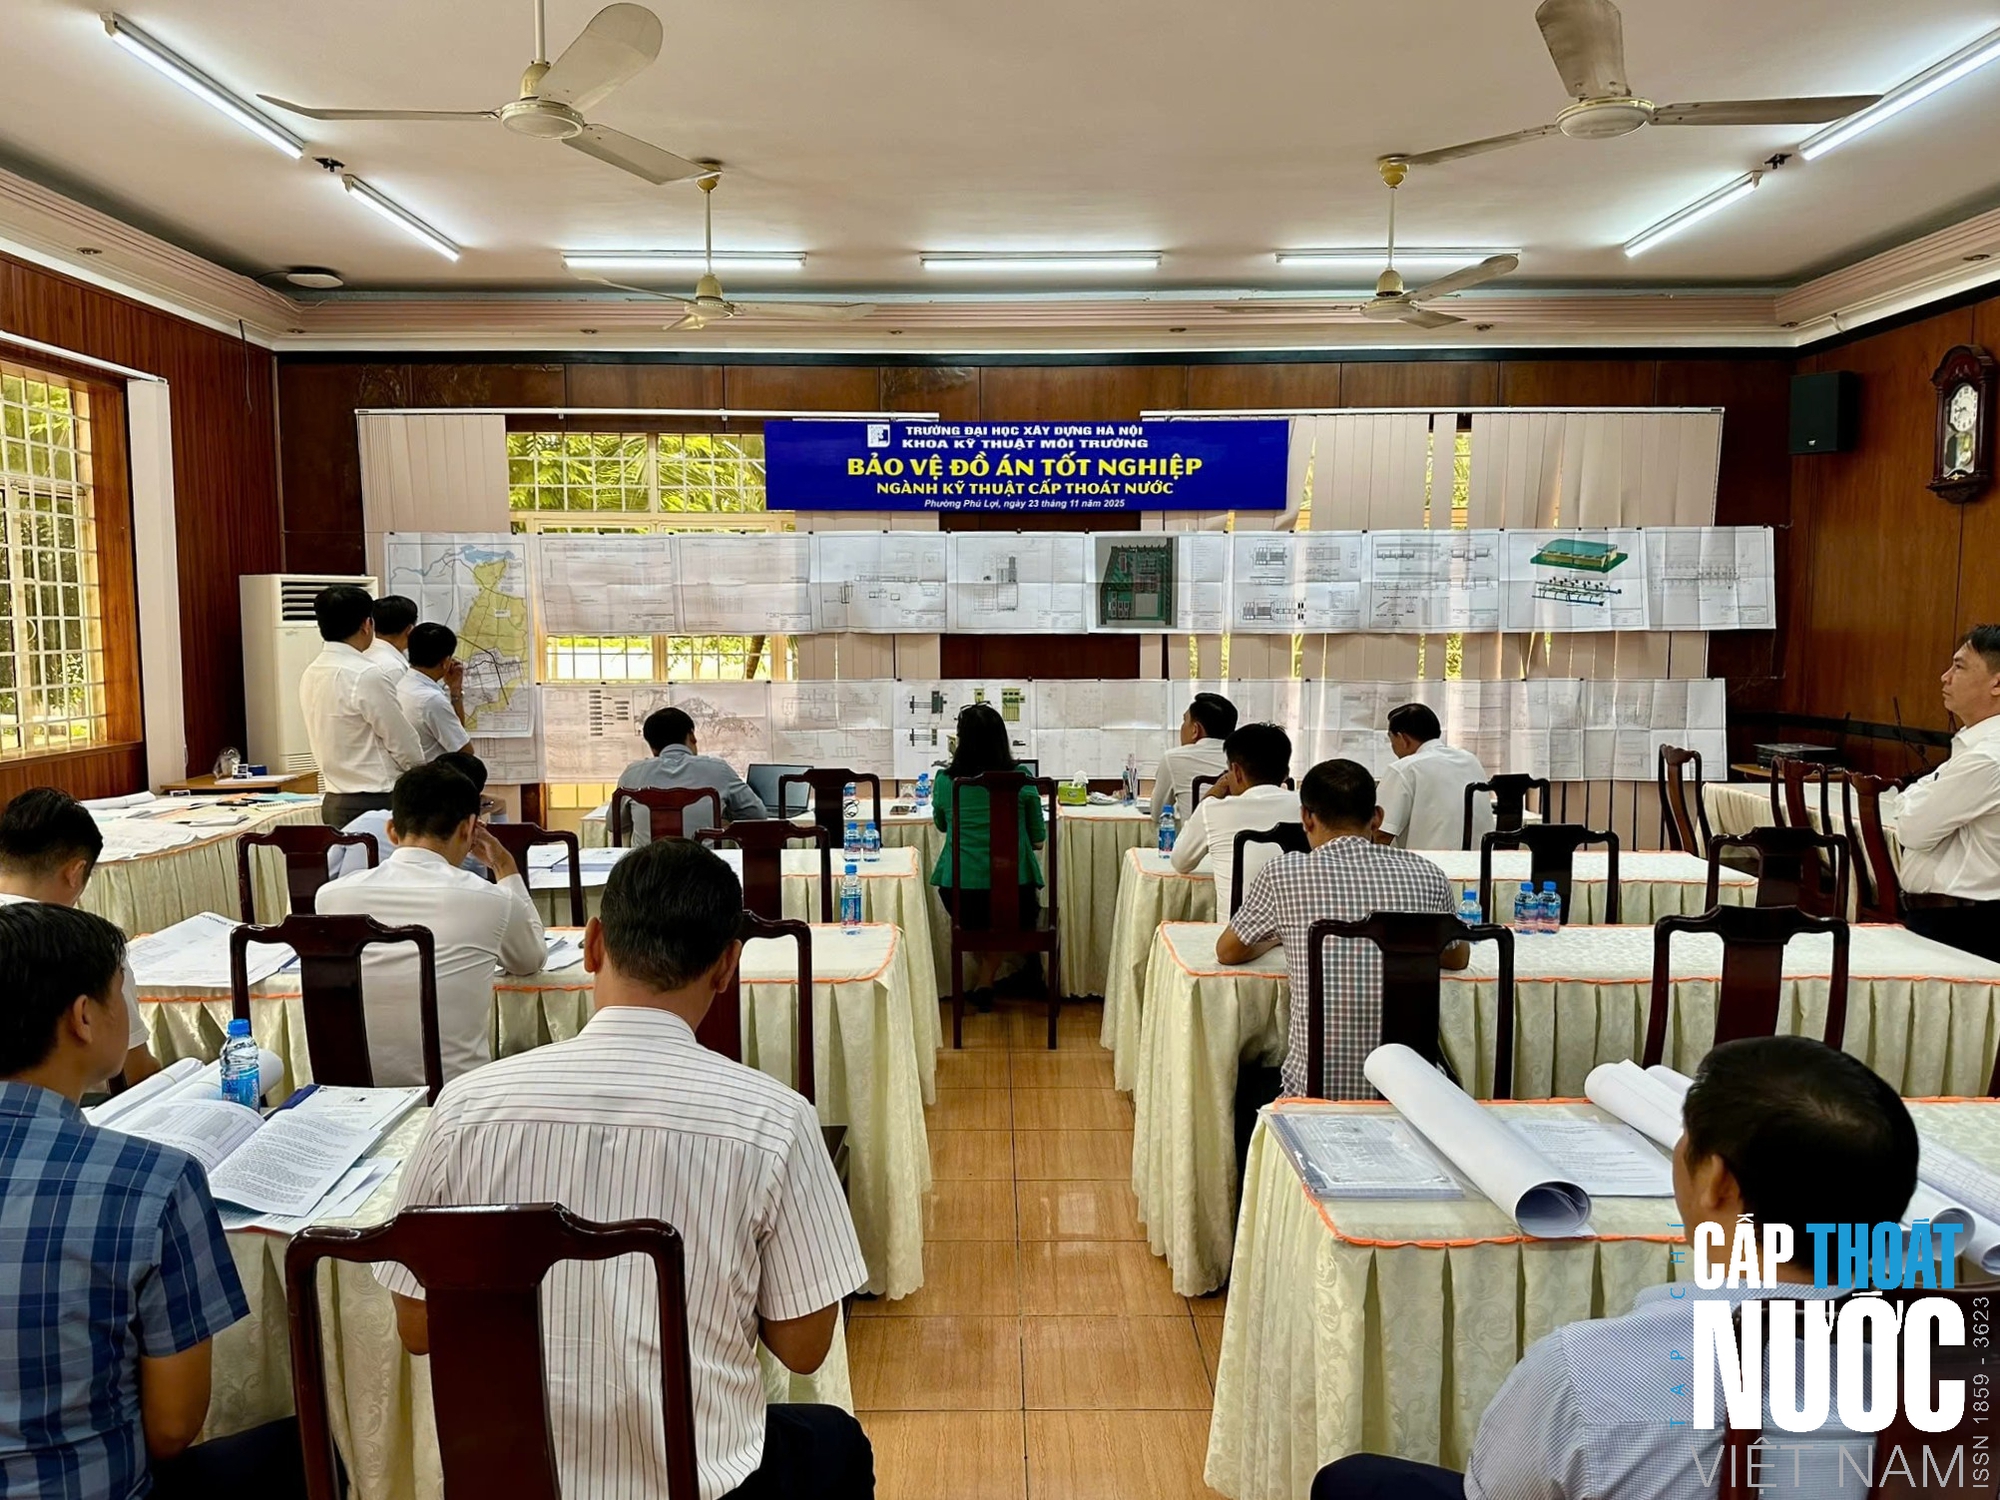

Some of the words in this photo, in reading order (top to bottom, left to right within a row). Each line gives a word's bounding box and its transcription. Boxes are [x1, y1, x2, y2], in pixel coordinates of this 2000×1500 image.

[905, 425, 960, 436] TRƯỜNG
[964, 426, 988, 437] ĐẠI
[991, 426, 1020, 437] HỌC
[1023, 425, 1050, 436] XÂY
[1054, 426, 1092, 437] DỰNG
[1096, 425, 1115, 436] HÀ
[1118, 425, 1143, 437] NỘI
[902, 439, 949, 449] KHOA
[953, 438, 976, 449] KỸ
[981, 438, 1036, 451] THUẬT
[1040, 438, 1074, 449] MÔI
[1079, 437, 1149, 449] TRƯỜNG
[847, 452, 904, 476] BẢO
[909, 453, 943, 481] VỆ
[949, 451, 990, 476] ĐỒ
[995, 453, 1034, 476] ÁN
[1041, 451, 1092, 476] TỐT
[1098, 453, 1203, 480] NGHIỆP
[876, 481, 938, 494] NGÀNH
[942, 480, 966, 495] KỸ
[969, 480, 1025, 497] THUẬT
[1028, 479, 1062, 495] CẤP
[1065, 480, 1121, 494] THOÁT
[1124, 480, 1174, 494] NƯỚC
[924, 499, 962, 510] Phường
[963, 499, 981, 508] Phú
[983, 499, 1001, 510] Lợi,
[1003, 500, 1026, 510] ngày
[1028, 500, 1039, 508] 23
[1041, 499, 1067, 510] tháng
[1069, 500, 1079, 508] 11
[1081, 500, 1101, 508] năm
[1103, 500, 1125, 508] 2025
